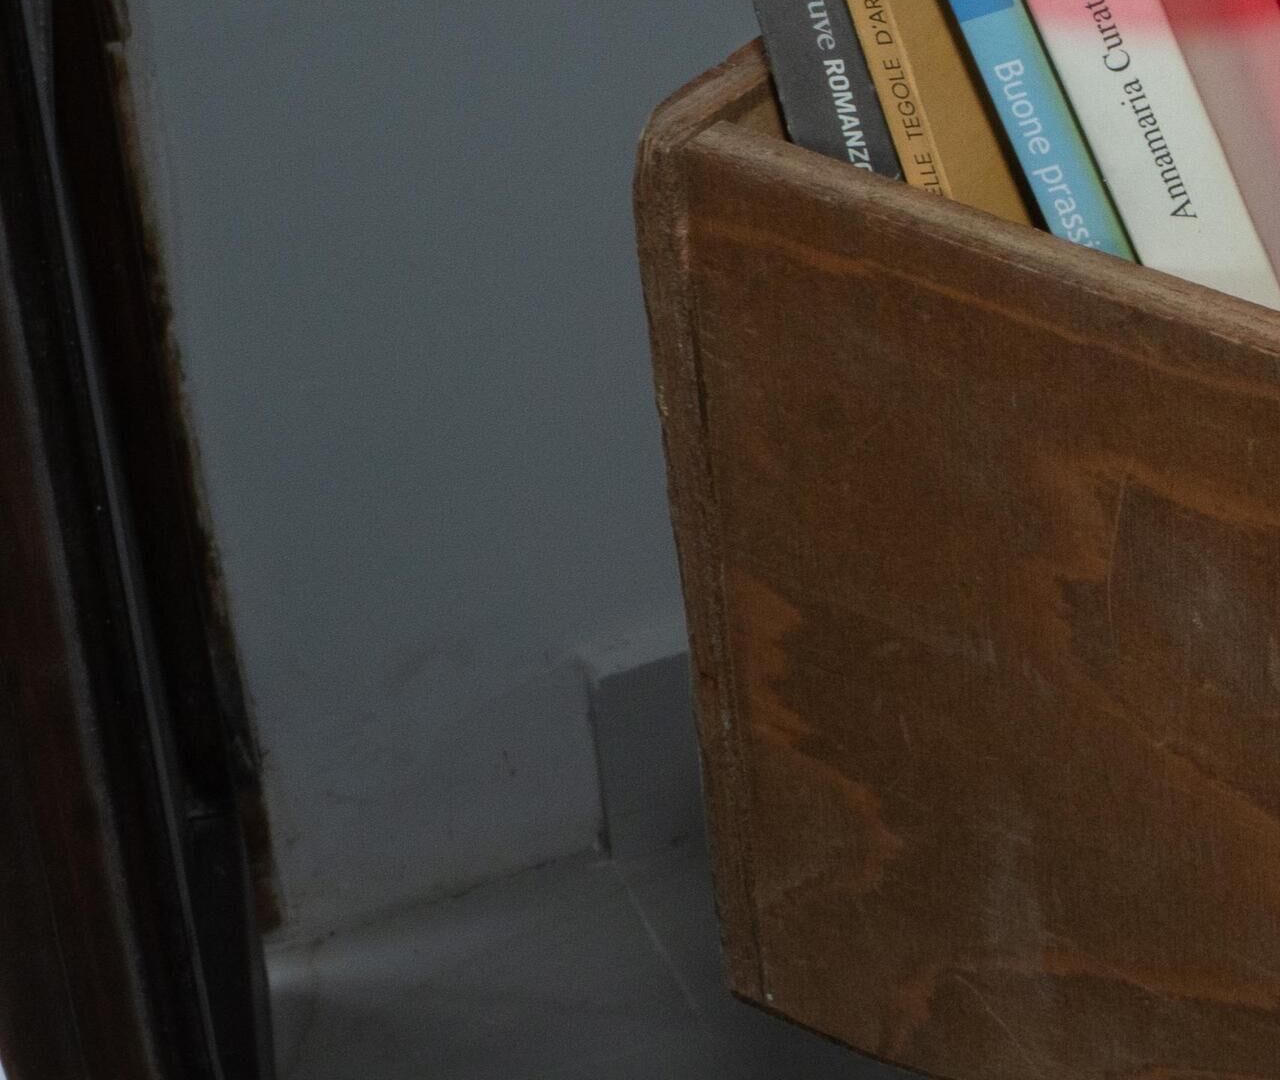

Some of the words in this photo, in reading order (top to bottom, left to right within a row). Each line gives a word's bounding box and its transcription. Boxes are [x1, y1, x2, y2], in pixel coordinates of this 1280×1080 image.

[882, 56, 924, 142] TEGOLE
[994, 58, 1051, 156] Buone
[1119, 78, 1199, 221] Annamaria
